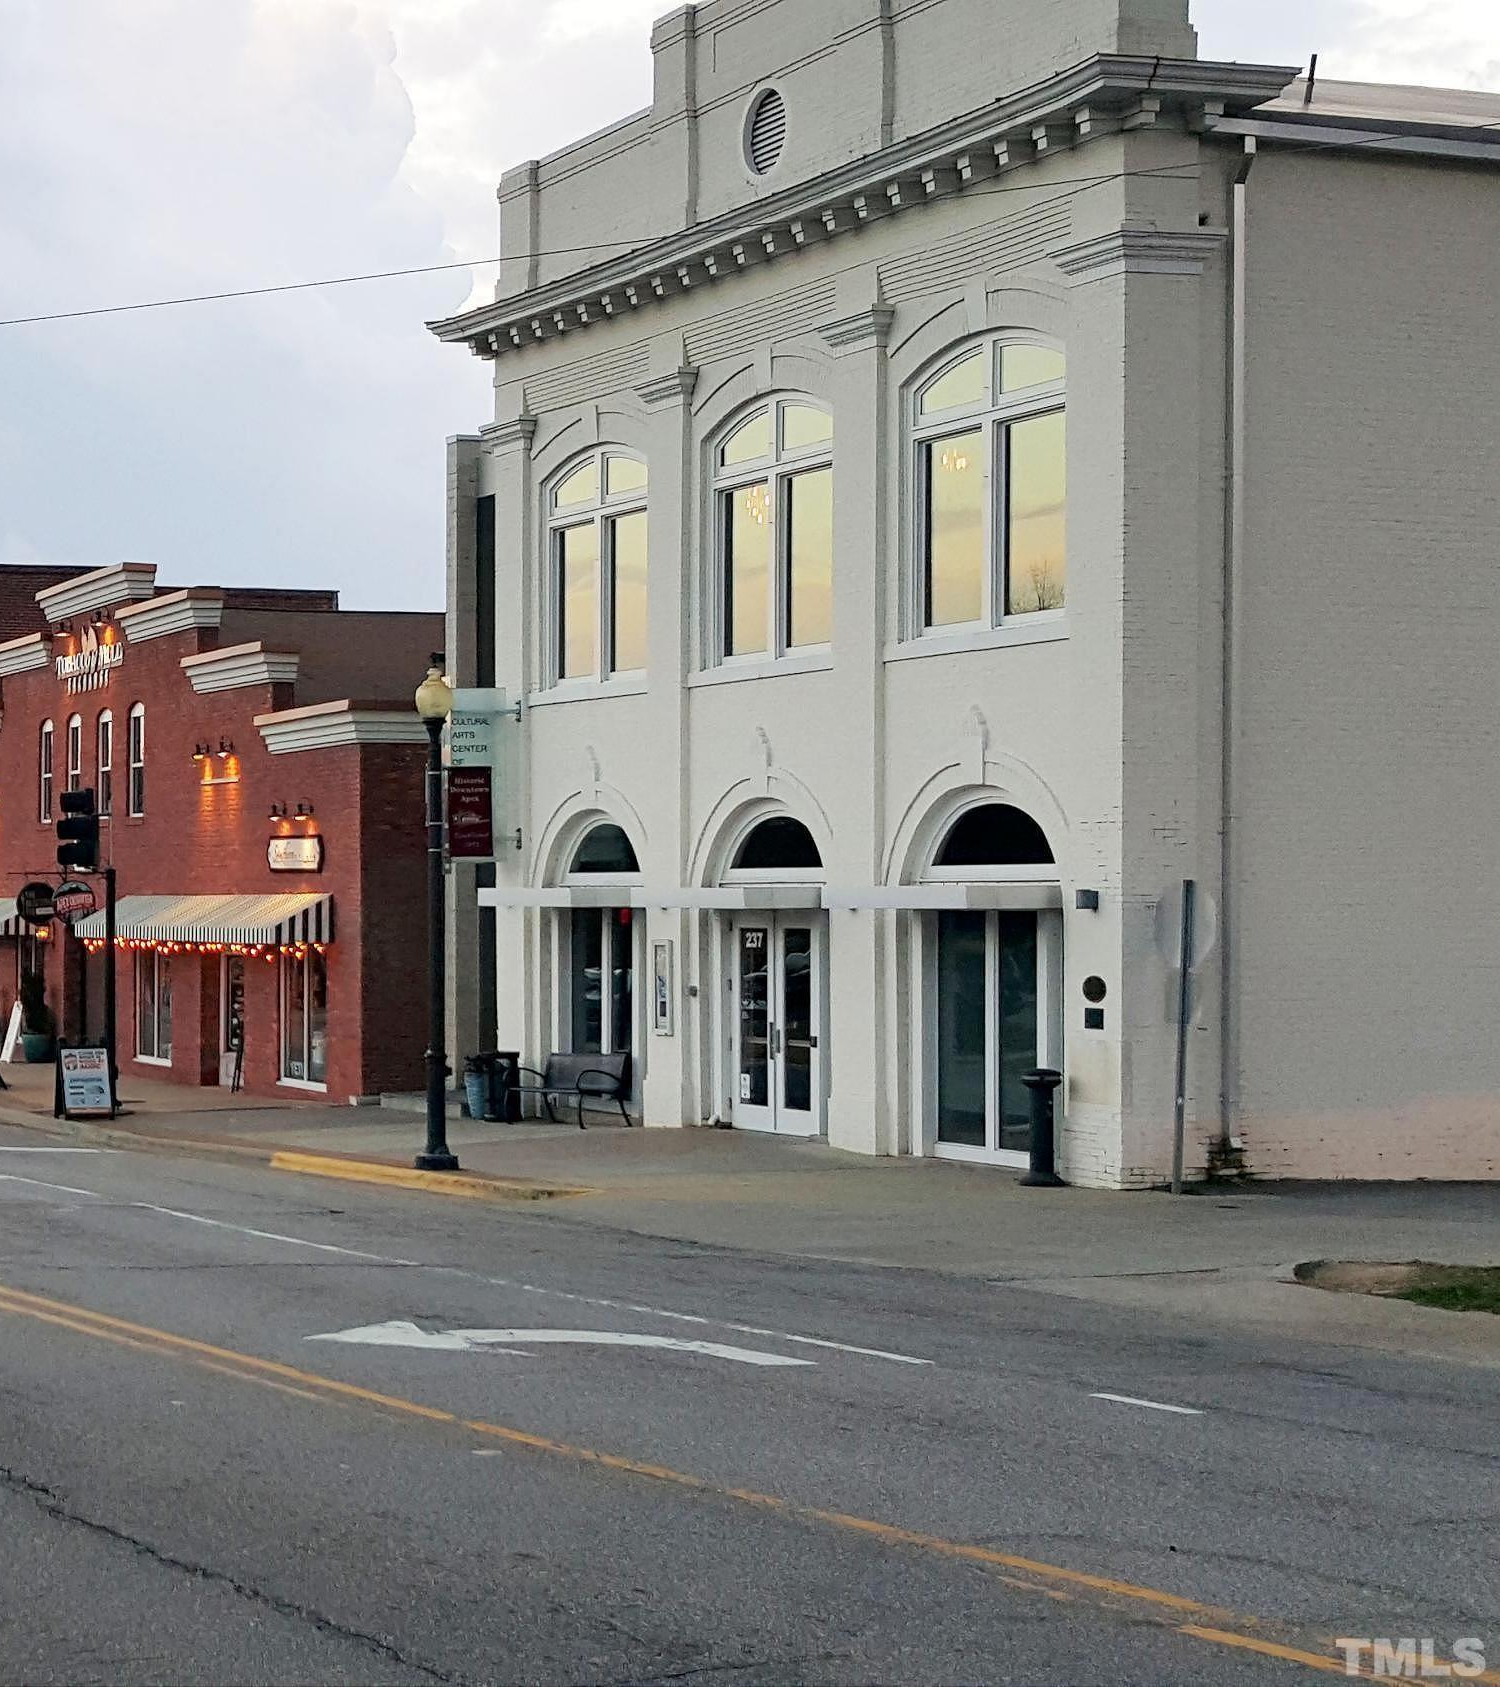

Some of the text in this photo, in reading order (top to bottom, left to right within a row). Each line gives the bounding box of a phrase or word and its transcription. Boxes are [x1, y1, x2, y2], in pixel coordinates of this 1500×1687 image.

[451, 718, 491, 726] CULTURAL
[452, 731, 476, 739] ARTS
[452, 744, 488, 753] CENTER
[452, 758, 465, 766] OF
[745, 931, 764, 948] 237
